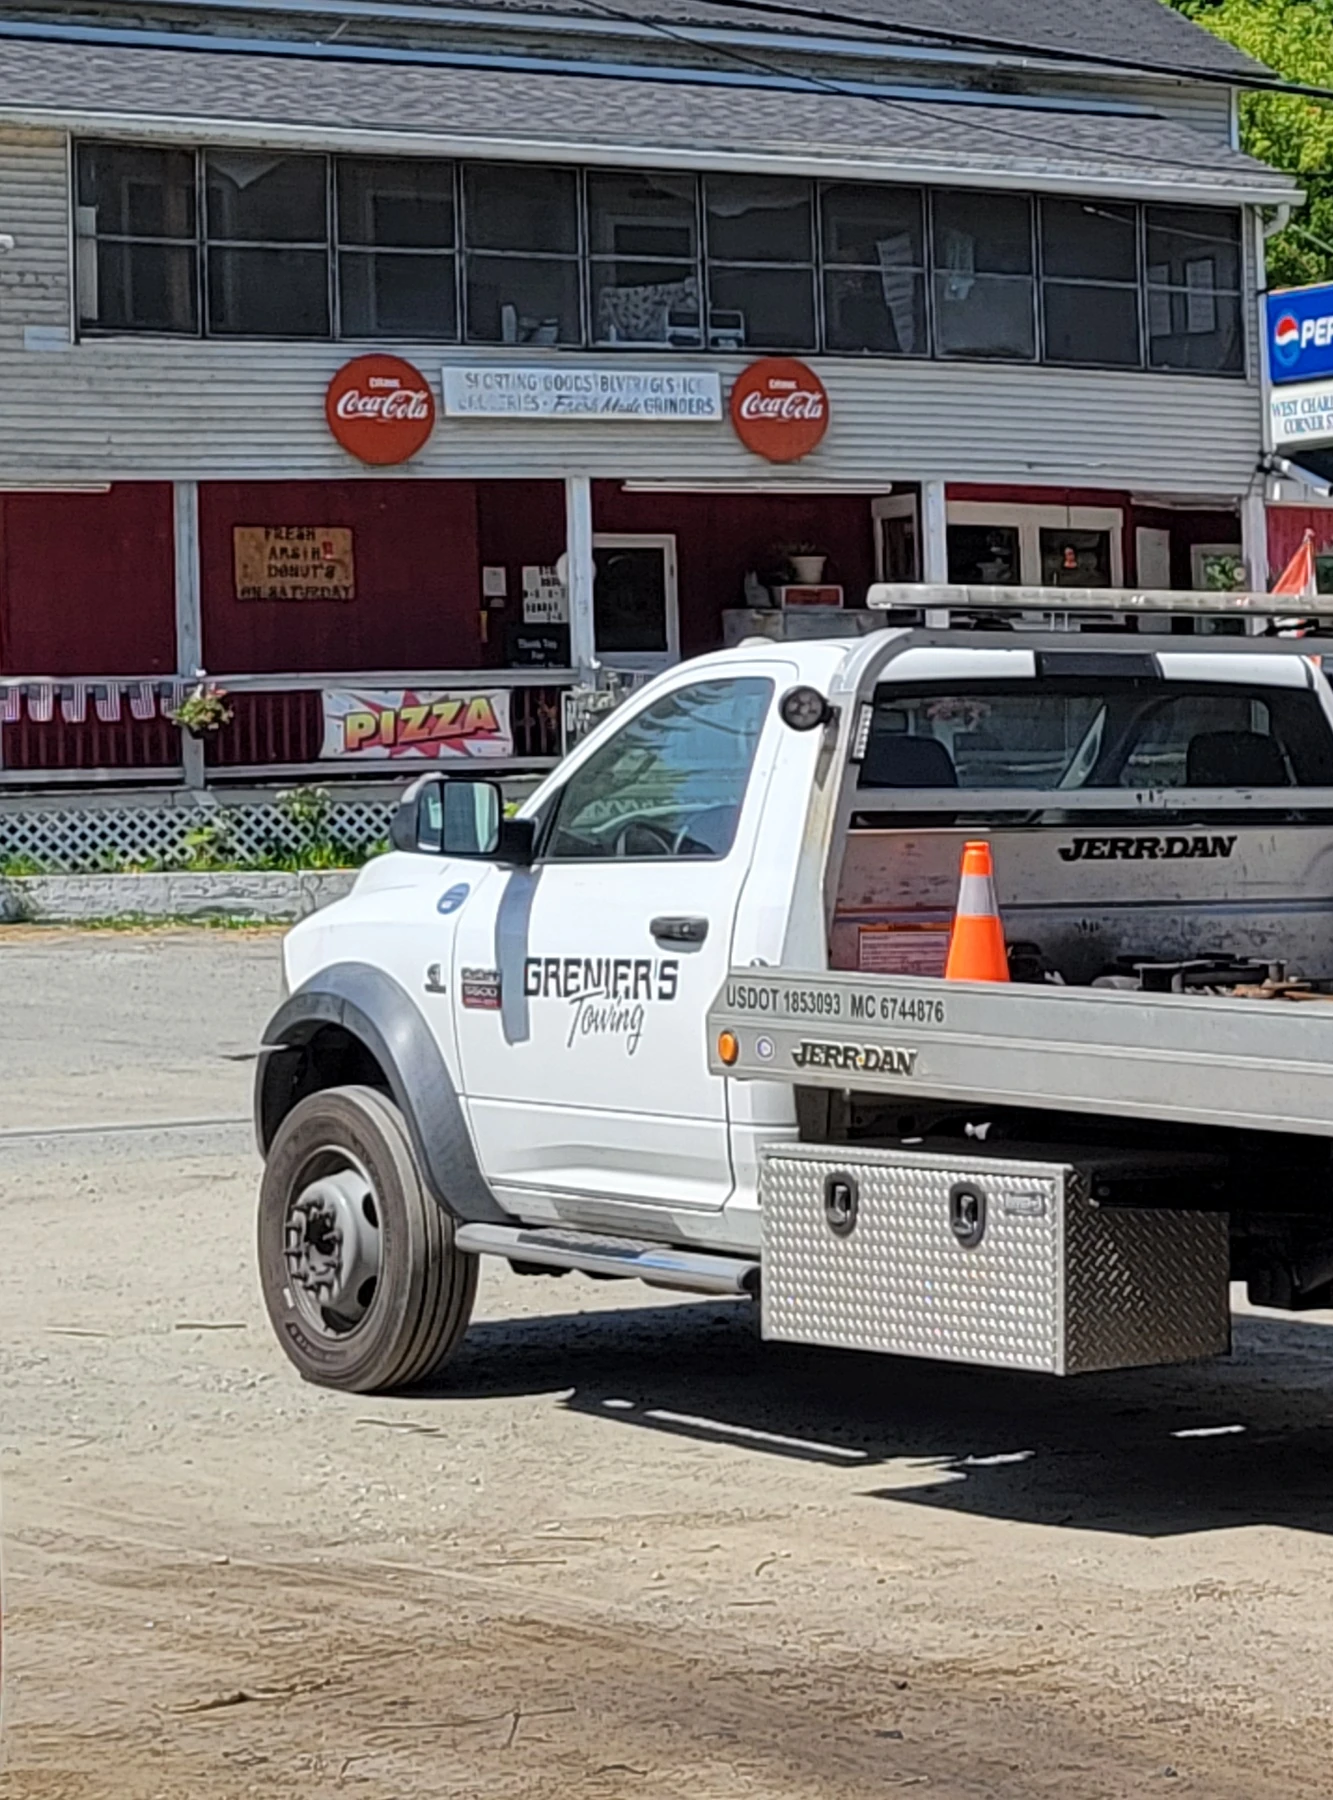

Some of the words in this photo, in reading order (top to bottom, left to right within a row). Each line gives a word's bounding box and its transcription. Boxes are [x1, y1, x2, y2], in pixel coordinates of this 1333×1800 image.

[337, 389, 429, 420] Coca-Cola
[741, 390, 823, 420] Coca-Cola
[1271, 401, 1298, 418] WEST
[1284, 416, 1325, 435] CORNER
[345, 696, 500, 751] PIZZA
[524, 957, 680, 1000] GRENIER'S
[726, 984, 780, 1012] USDOT
[783, 990, 841, 1016] 1853093
[850, 994, 876, 1019] MC
[880, 997, 945, 1023] 6744876
[567, 990, 645, 1056] Towing
